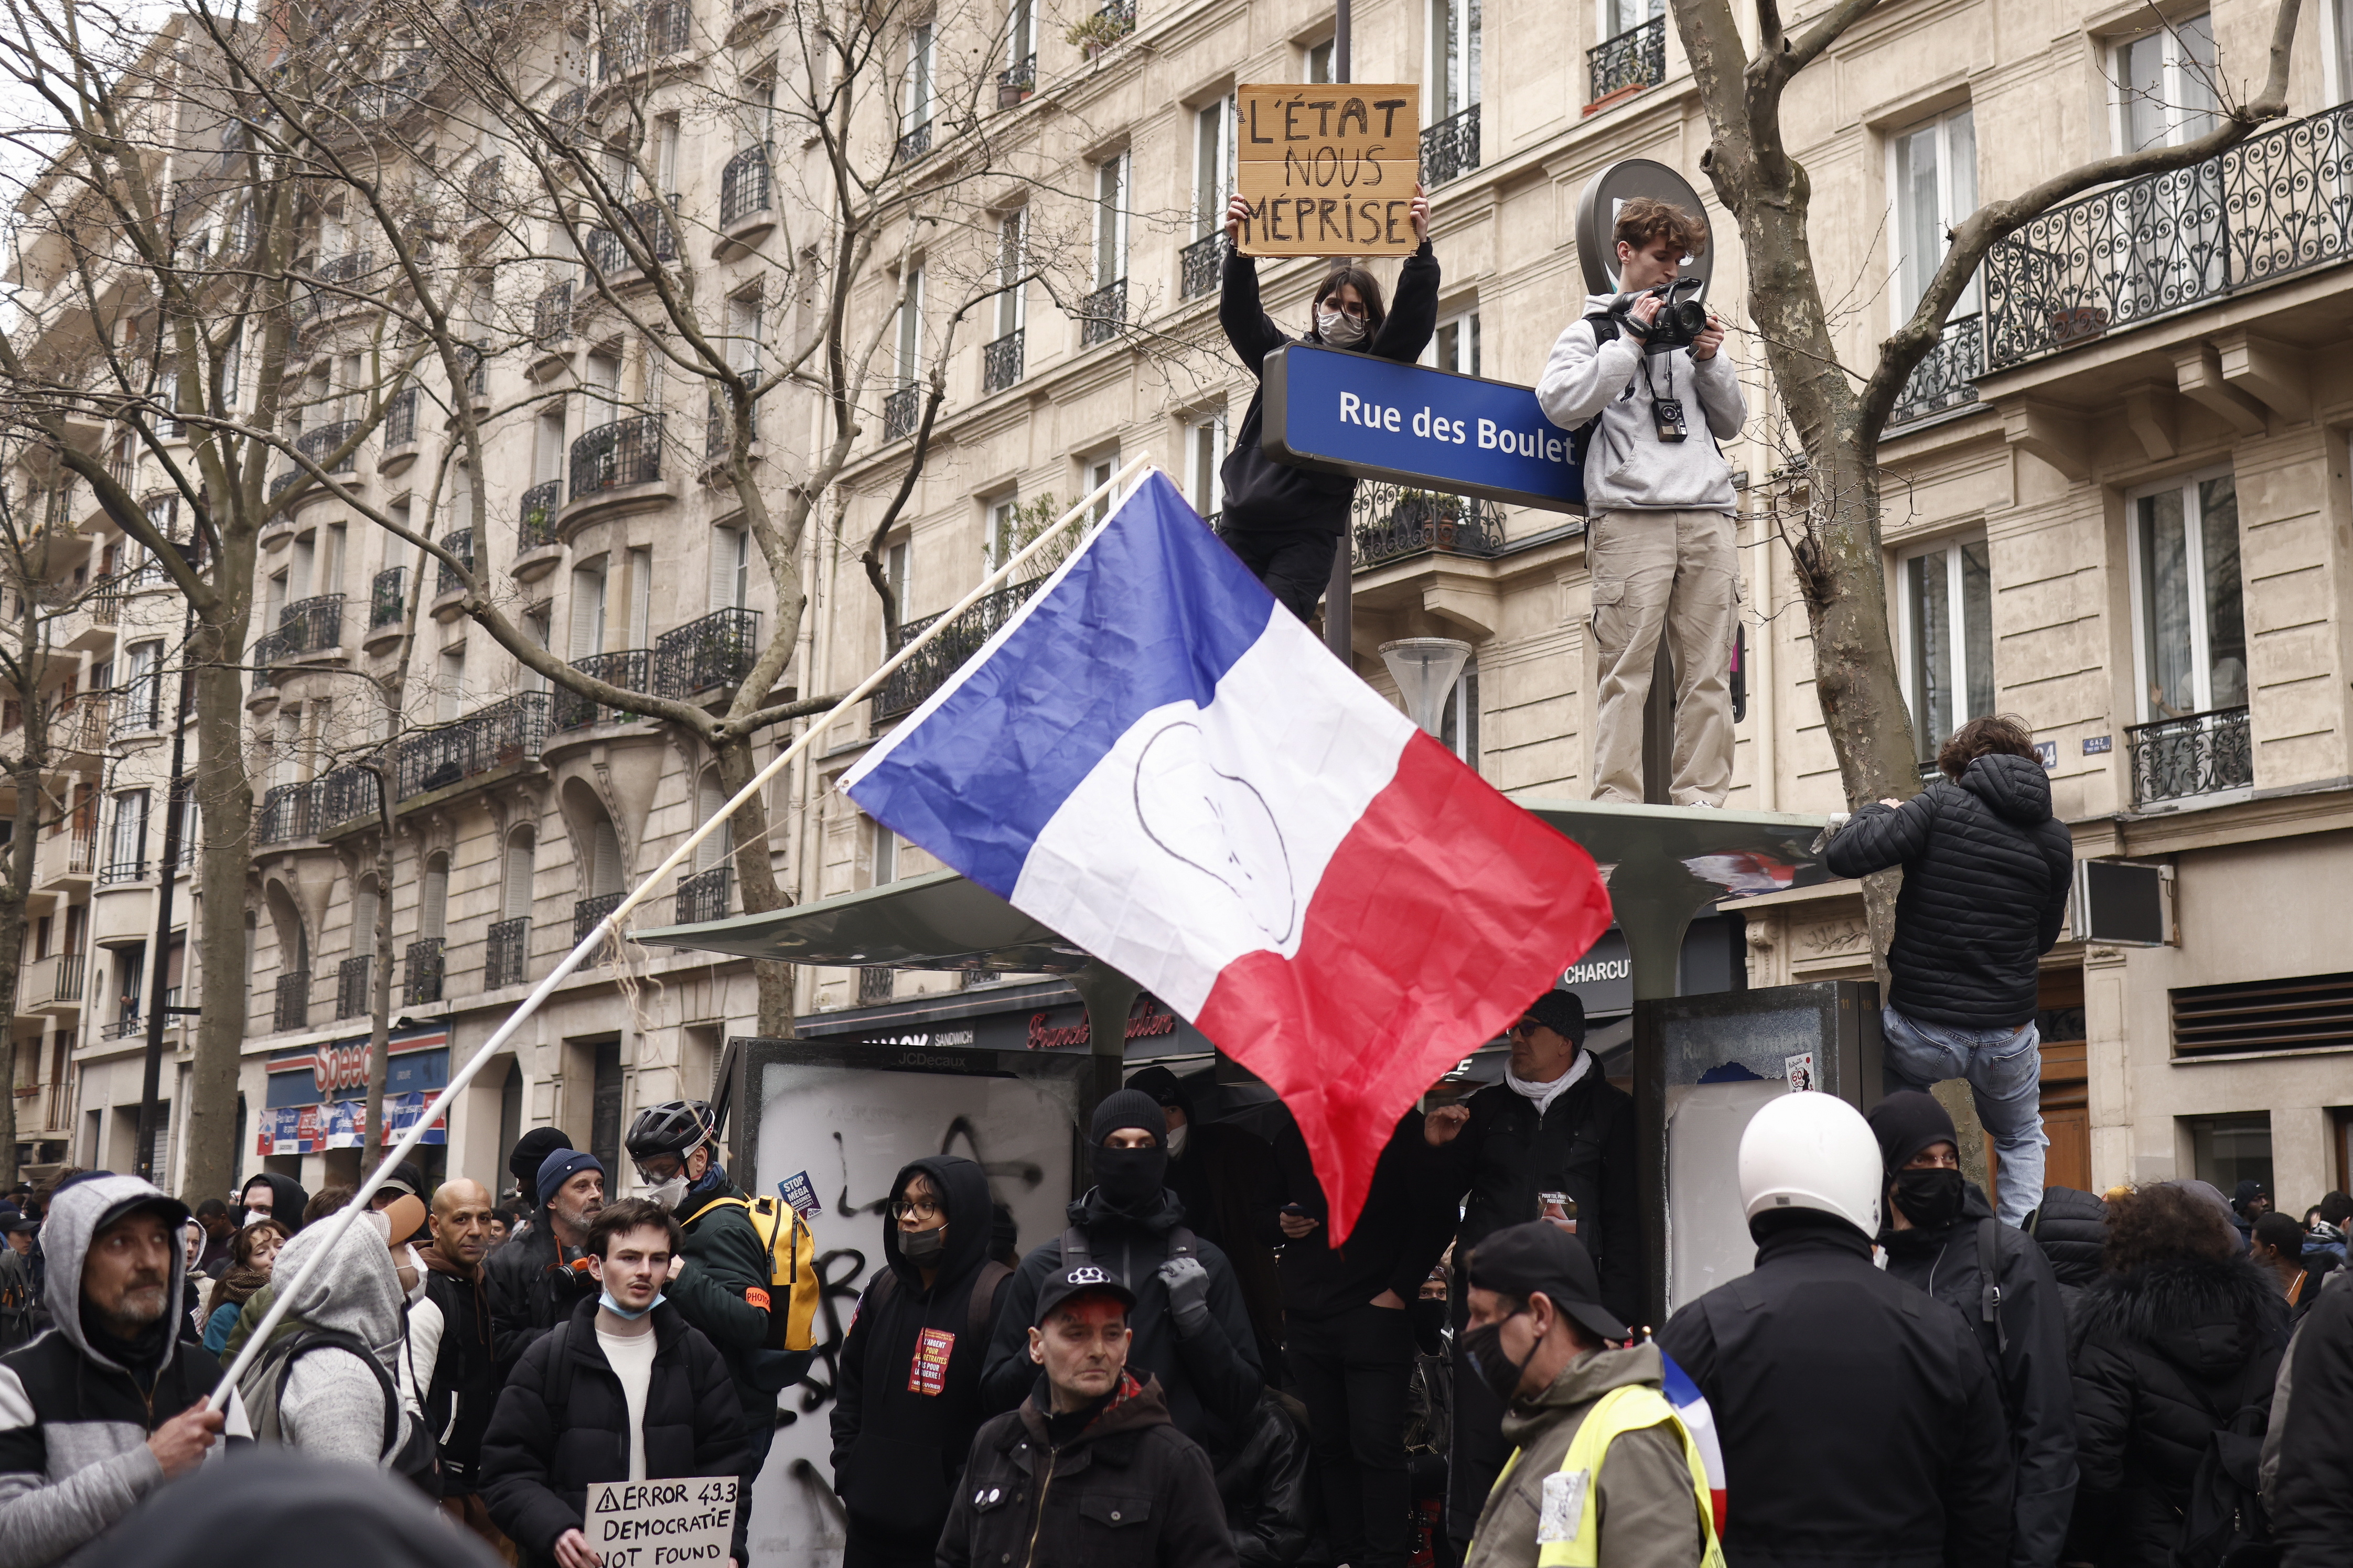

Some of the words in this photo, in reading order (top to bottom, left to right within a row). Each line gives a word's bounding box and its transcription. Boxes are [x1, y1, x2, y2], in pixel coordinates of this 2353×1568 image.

[1250, 93, 1406, 144] L'ÉTAT
[1285, 145, 1385, 187] NOUS
[1244, 193, 1407, 246] MÉPRISE
[1626, 317, 1645, 333] Panasonic
[1340, 391, 1401, 432] Rue
[1412, 406, 1466, 445] des
[1478, 418, 1578, 466] Boulet
[1564, 959, 1631, 985] CHARCU
[1841, 998, 1849, 1009] 11
[1026, 1009, 1090, 1049] Franck
[1125, 1001, 1174, 1038] ulien
[935, 1030, 973, 1047] SANDWICH
[899, 1052, 966, 1067] JCDecaux
[1788, 1057, 1803, 1069] Retraite
[1792, 1070, 1802, 1082] 60
[783, 1175, 803, 1192] STOP
[787, 1186, 809, 1202] MÉGA
[790, 1194, 811, 1206] BASSINES
[797, 1202, 812, 1212] ommun
[924, 1338, 946, 1349] L'ARGENT
[926, 1347, 939, 1355] POUR
[923, 1355, 947, 1365] RETRAITES
[927, 1363, 940, 1371] POUR
[623, 1484, 689, 1510] ERROR
[698, 1483, 737, 1506] 49.3
[595, 1548, 642, 1568] NOT
[656, 1544, 721, 1565] FOUND
